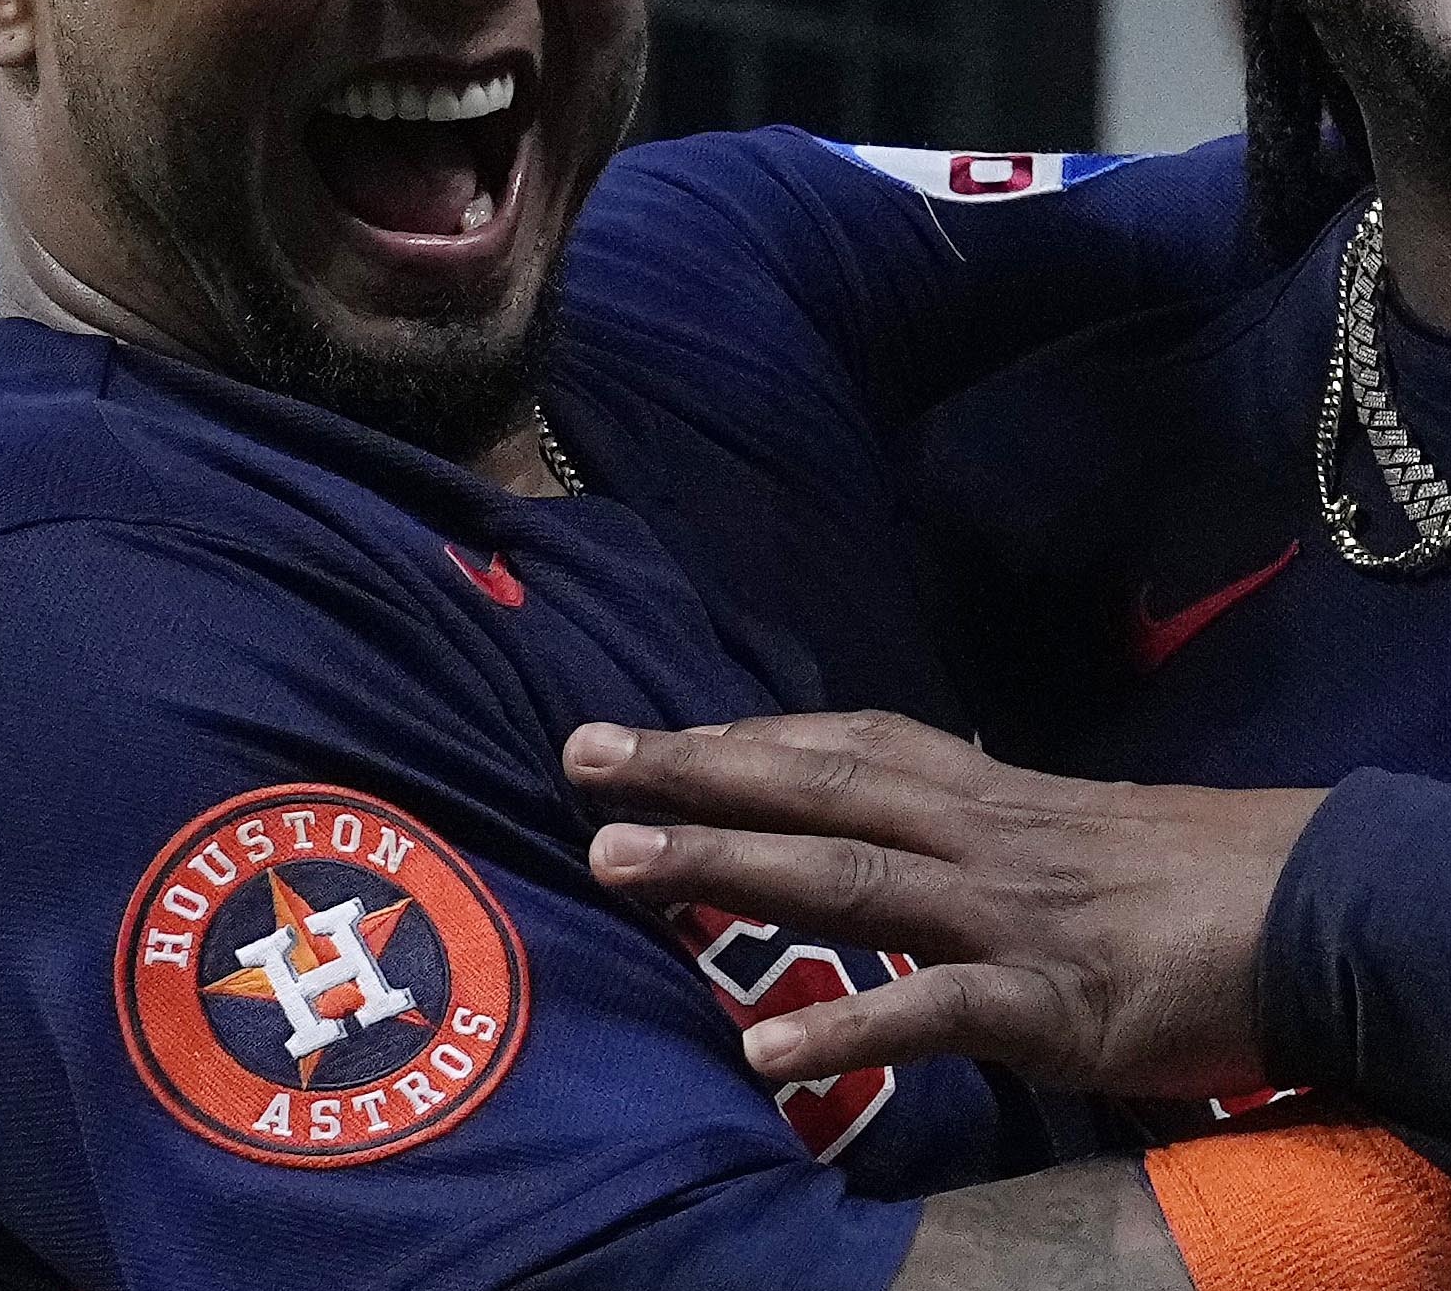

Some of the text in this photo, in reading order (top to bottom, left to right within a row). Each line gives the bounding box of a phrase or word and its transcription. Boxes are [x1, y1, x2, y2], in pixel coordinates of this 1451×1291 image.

[144, 810, 414, 968] HOUSTON
[234, 896, 415, 1060] H
[253, 1006, 497, 1141] ASTROS
